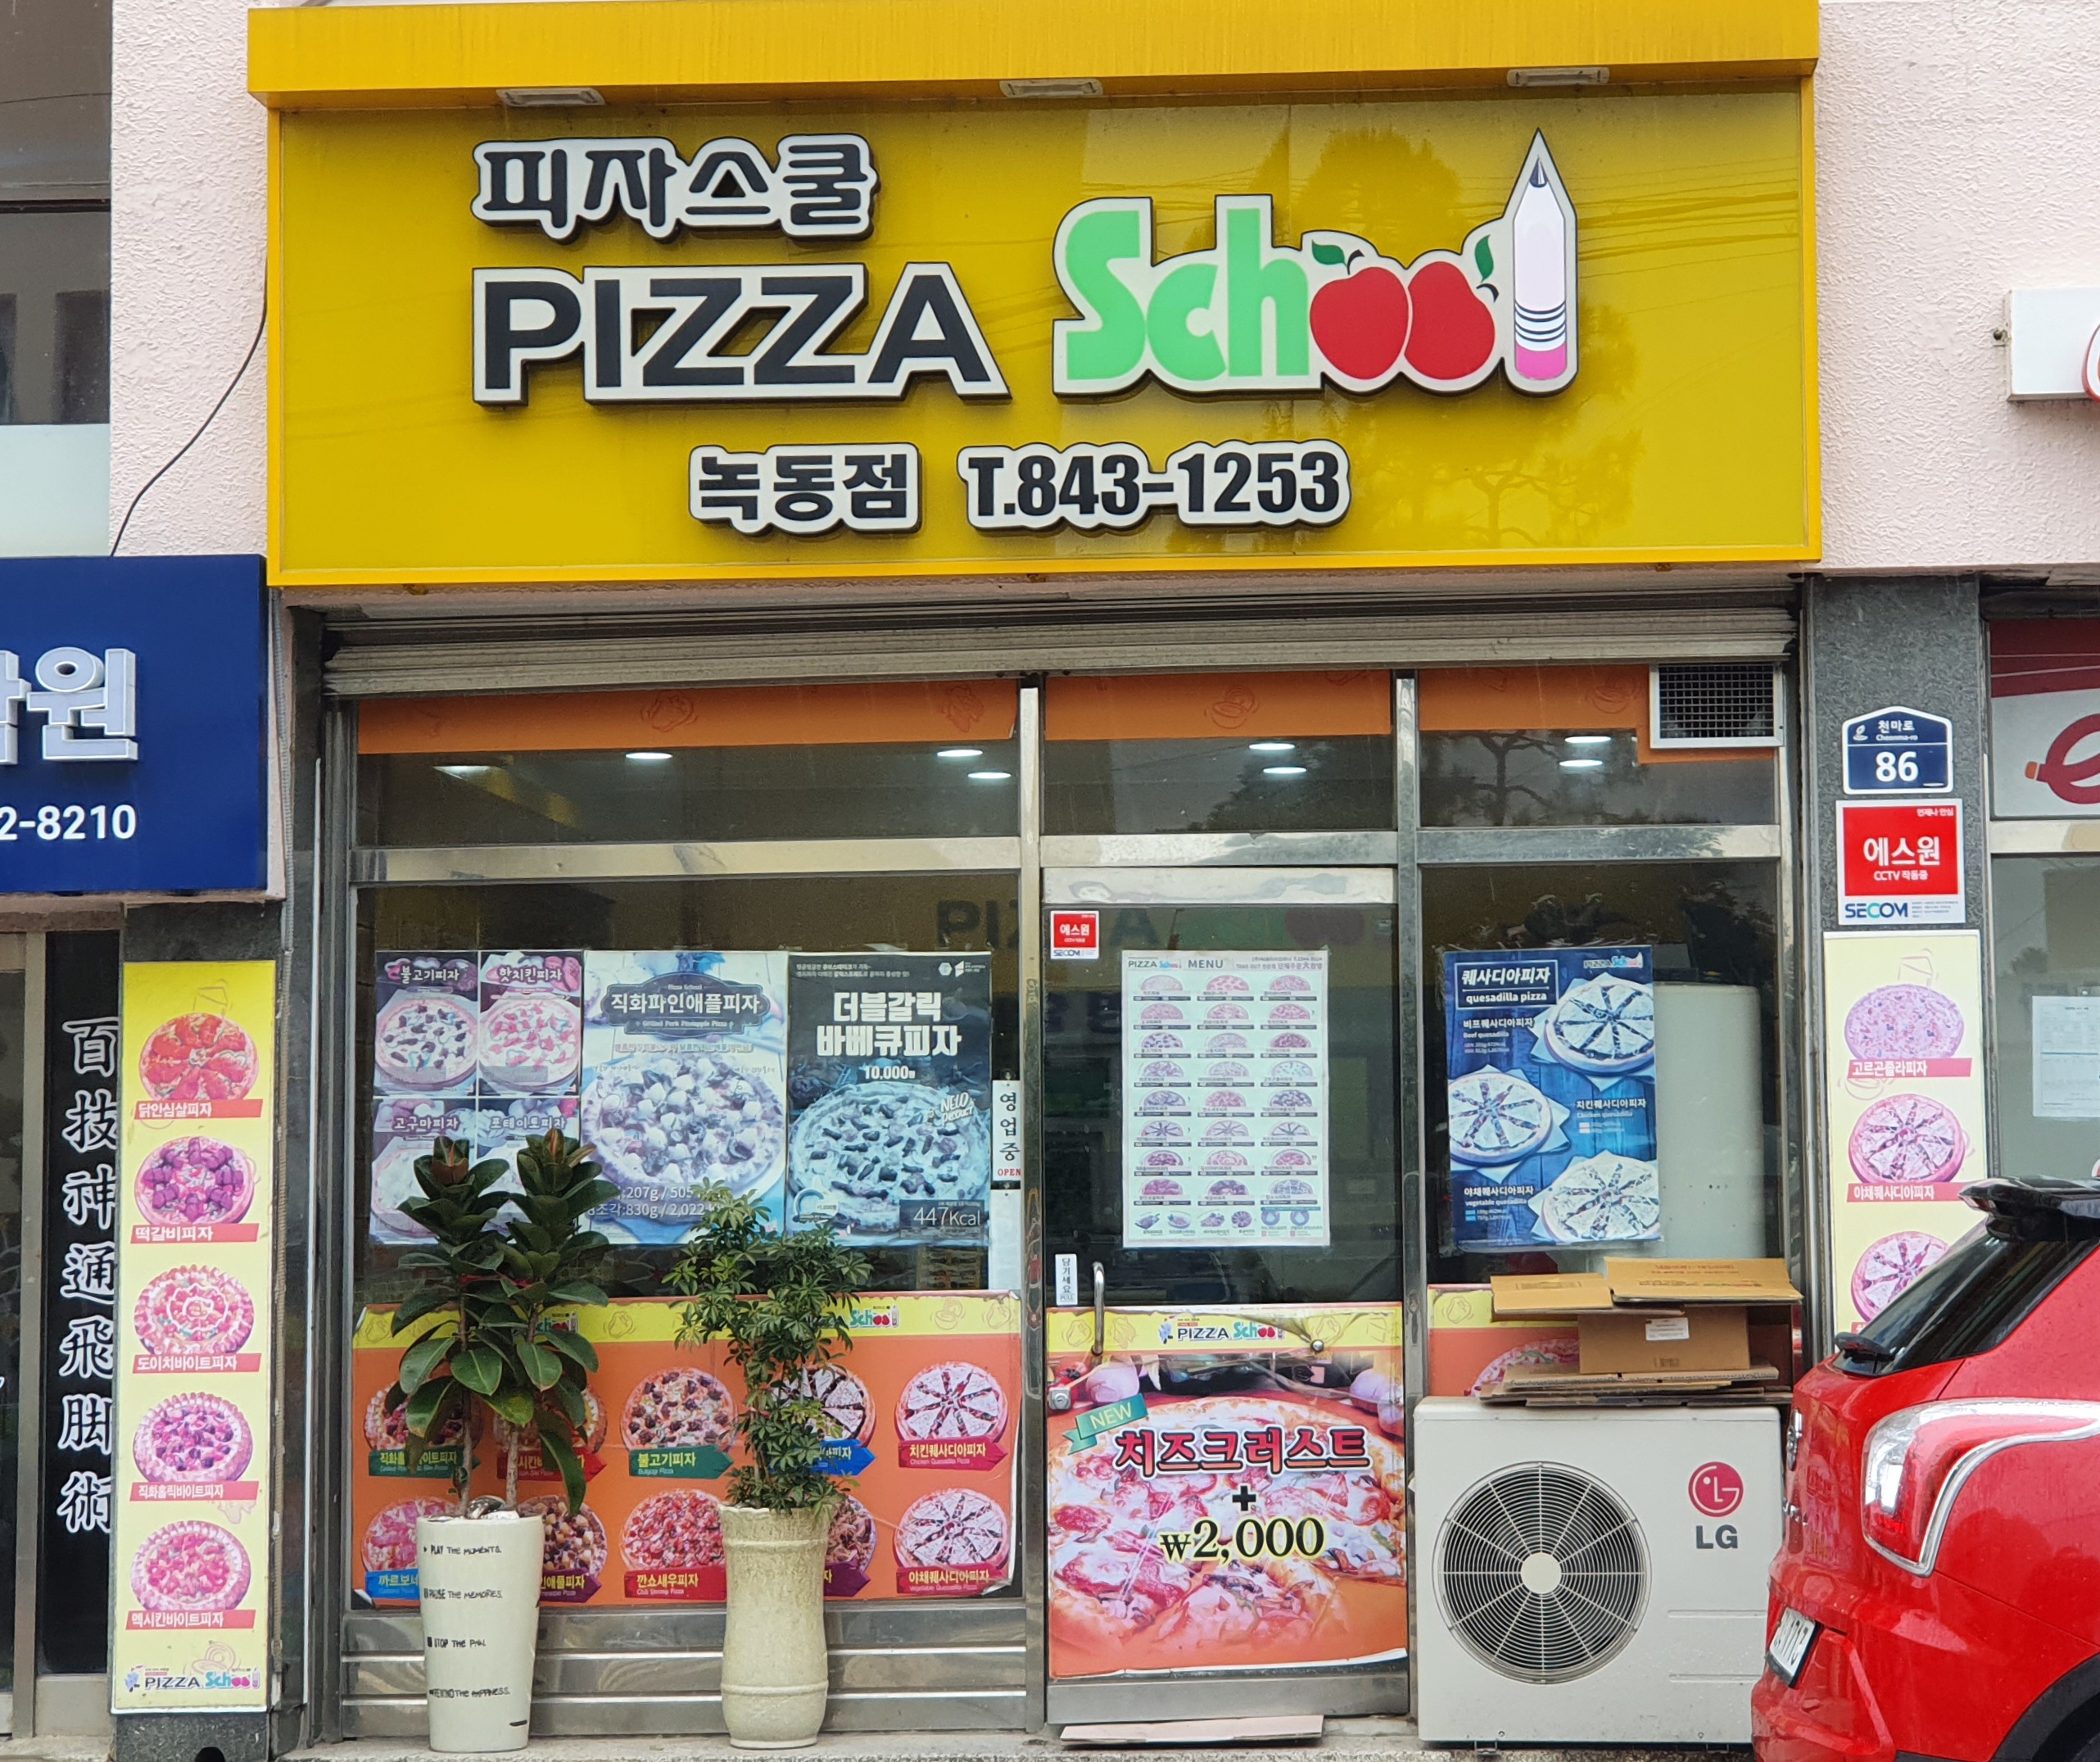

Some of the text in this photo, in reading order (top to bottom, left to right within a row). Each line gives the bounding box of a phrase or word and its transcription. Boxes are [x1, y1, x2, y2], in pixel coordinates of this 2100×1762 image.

[482, 143, 869, 230] 피자스쿨
[485, 141, 1573, 390] PIZZA School
[699, 453, 908, 523] 녹동점
[967, 452, 1341, 518] T.843-1253
[1877, 720, 1915, 734] 천마로
[1876, 751, 1918, 782] 86
[1863, 836, 1940, 867] 에스원
[1873, 871, 1900, 881] CCTV
[1845, 903, 1908, 919] SECOM
[1060, 923, 1090, 936] 에스원
[1128, 959, 1157, 968] PIZZA
[1188, 959, 1224, 969] MENU
[401, 966, 460, 984] 불고기피자
[499, 966, 563, 983] 핫치킨피자
[1462, 967, 1551, 986] 퀘사디아피자
[611, 993, 760, 1015] 직화파인애플피자
[833, 991, 943, 1022] 더블갈릭
[1465, 991, 1548, 1005] quesadilla pizza
[1463, 1017, 1534, 1030] 비프퀘사디아피자
[817, 1024, 963, 1058] 바베큐피자
[1852, 1059, 1927, 1076] 고르곤졸라피자
[138, 1102, 212, 1119] 닭안심살피자
[1576, 1098, 1646, 1110] 치킨퀘사디아피자
[393, 1116, 459, 1132] 고구마피자
[491, 1115, 567, 1130] 포테이토피자
[1000, 1091, 1021, 1162] 영업중
[998, 1168, 1022, 1176] OPEN
[1464, 1185, 1534, 1198] 야채퀘사디아피자
[1853, 1184, 1935, 1201] 야채퀘사디아피자
[912, 1207, 981, 1227] 447Kcal
[135, 1225, 214, 1243] 떡갈비피자
[1178, 1328, 1229, 1339] PIZZA
[137, 1354, 238, 1373] 도이치바이트피자
[1089, 1402, 1133, 1432] NEW
[909, 1442, 986, 1458] 치킨퀘사디아피자
[1114, 1427, 1371, 1476] 치즈크러스트
[638, 1452, 696, 1467] 불고기피자
[138, 1483, 224, 1500] 직화홀릭바이트피자
[1160, 1518, 1324, 1563] ₩2,000
[1695, 1525, 1739, 1549] LG
[636, 1572, 699, 1588] 깐쇼새우피자
[908, 1569, 990, 1585] 야채퀘사디아피자
[130, 1610, 224, 1628] 멕시칸바이트피자
[145, 1676, 201, 1688] PIZZA
